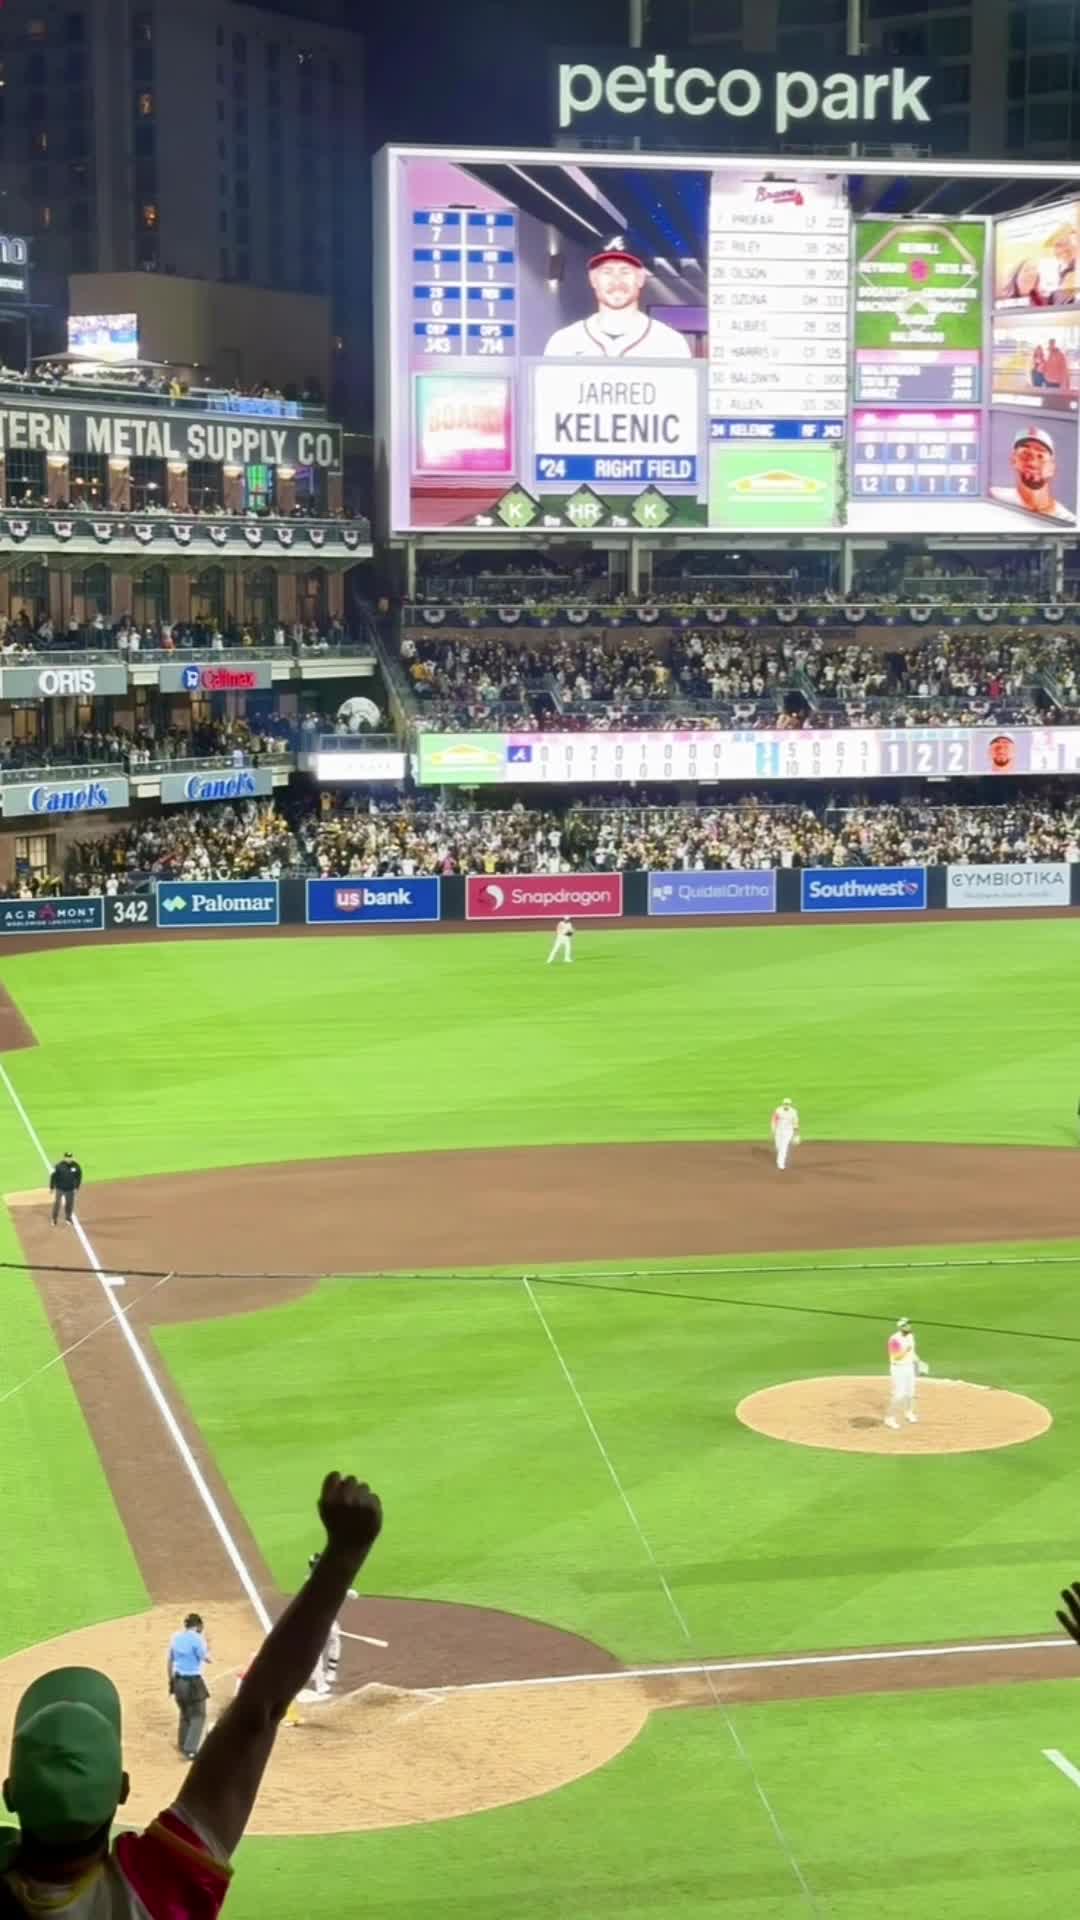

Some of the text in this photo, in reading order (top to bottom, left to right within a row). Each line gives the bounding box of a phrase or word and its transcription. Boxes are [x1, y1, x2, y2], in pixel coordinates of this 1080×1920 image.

[558, 54, 931, 133] petco park
[487, 228, 494, 244] 1
[434, 265, 441, 280] 1
[487, 266, 494, 281] 1
[431, 301, 443, 317] 0
[487, 302, 494, 317] 1
[577, 381, 657, 405] JARRED
[555, 412, 681, 444] KELENIC
[86, 416, 180, 459] METAL
[187, 424, 289, 464] SUPPLY
[298, 433, 339, 467] CO.
[539, 459, 692, 479] #24 RIGHT FIELD
[507, 502, 523, 519] K
[568, 502, 598, 520] HR
[643, 502, 657, 519] K
[39, 669, 97, 695] ORIS
[888, 742, 964, 772] 1 2 2
[184, 773, 256, 799] Canel's
[29, 784, 109, 813] Canel's
[952, 872, 1064, 887] CYMBIOTIKA
[364, 888, 411, 906] bank
[511, 888, 611, 909] Snapdragon
[678, 883, 769, 899] QuidelOrtho
[809, 880, 904, 899] Southwest
[113, 901, 149, 924] 342
[191, 895, 275, 913] Palomar
